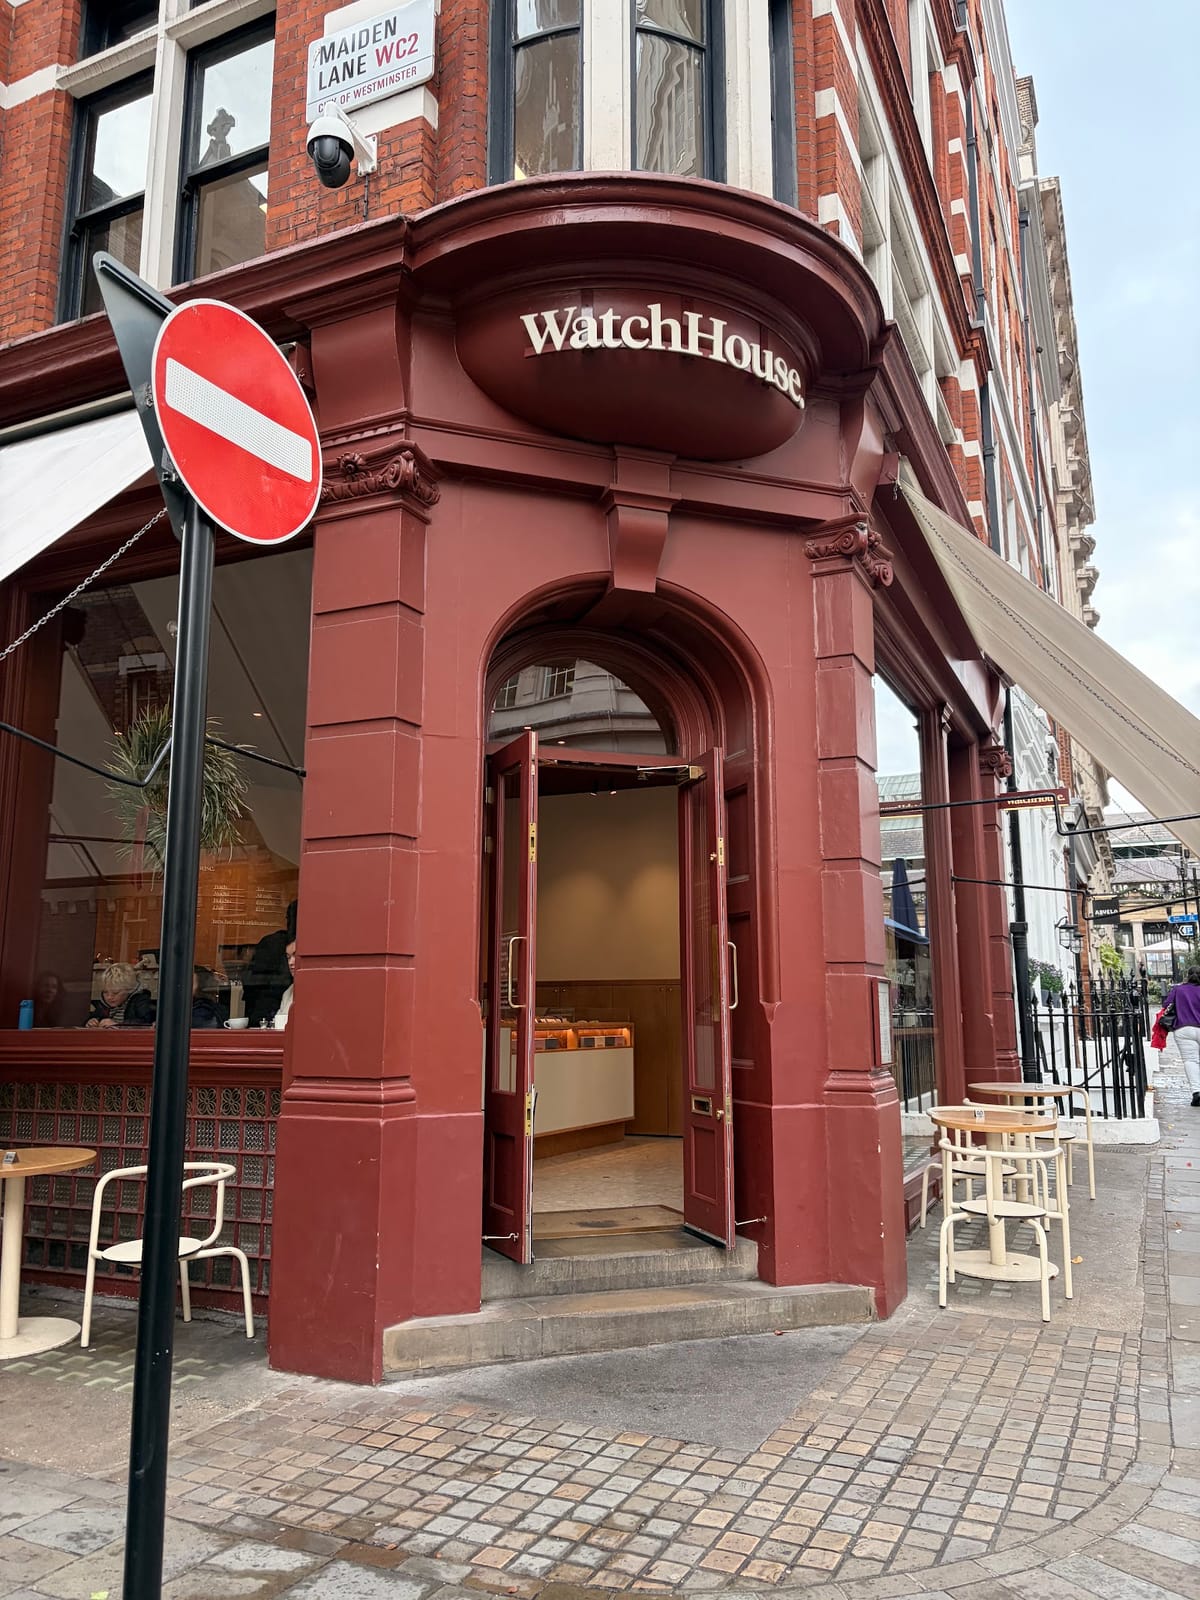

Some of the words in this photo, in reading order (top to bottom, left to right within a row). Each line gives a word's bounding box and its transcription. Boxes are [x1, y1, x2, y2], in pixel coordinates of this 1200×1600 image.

[318, 53, 367, 91] LANE
[375, 32, 419, 67] WC2
[319, 15, 398, 66] MAIDEN
[318, 97, 337, 113] CY
[340, 92, 351, 105] OF
[353, 65, 417, 99] WESTMINSTER
